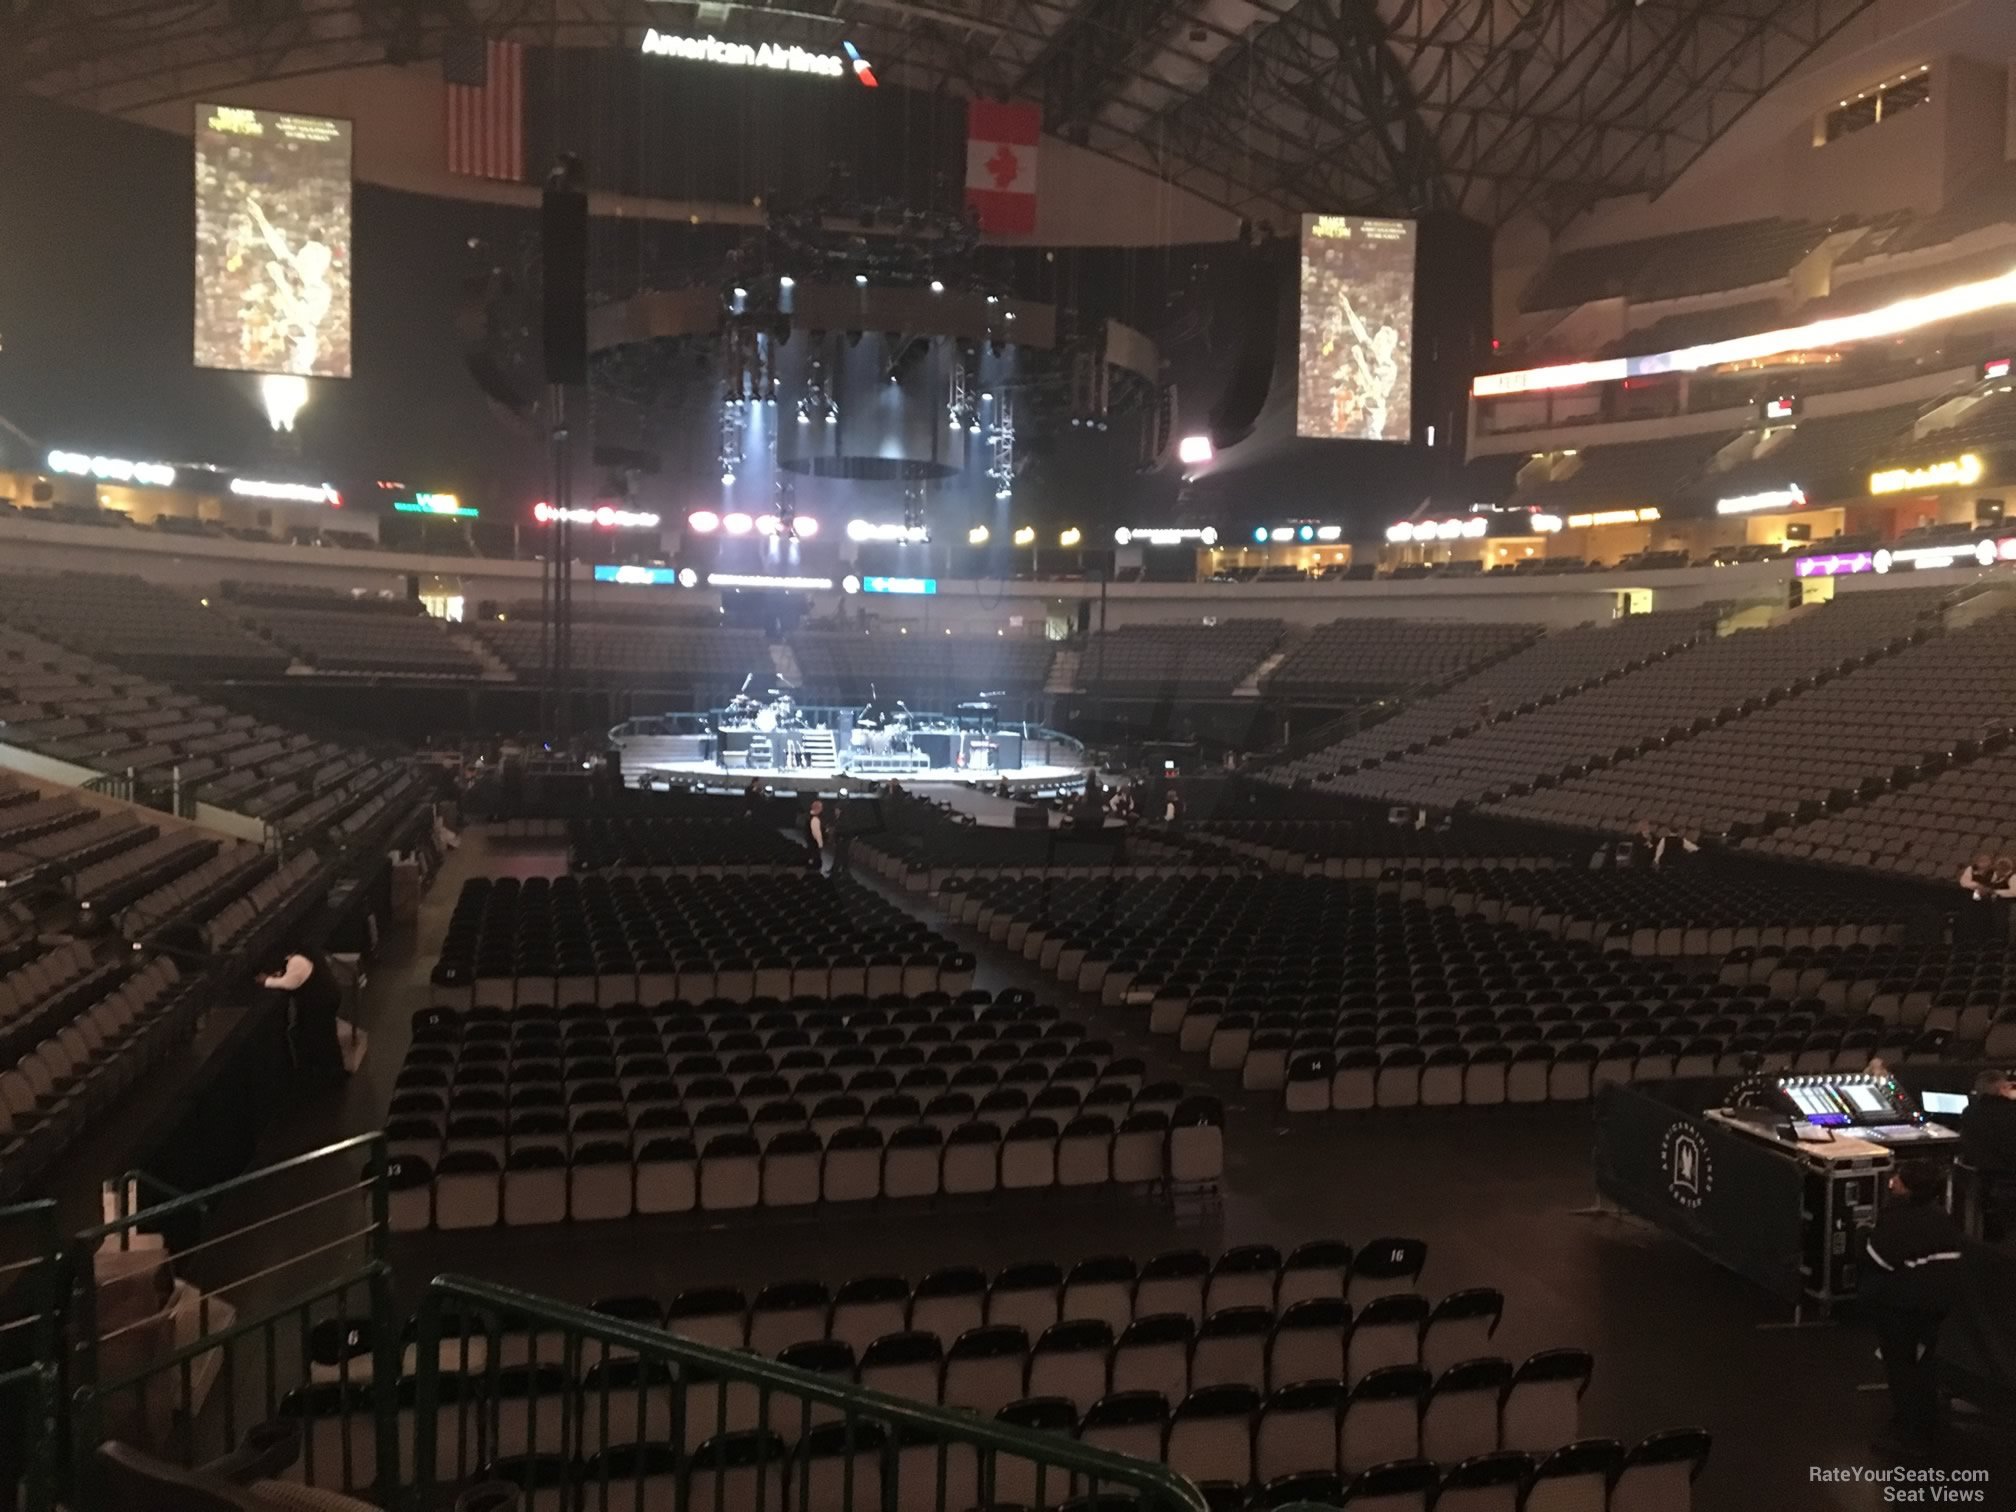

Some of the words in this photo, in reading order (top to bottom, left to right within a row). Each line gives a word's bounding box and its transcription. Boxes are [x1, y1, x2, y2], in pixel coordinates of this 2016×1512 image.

[641, 28, 755, 65] American
[756, 42, 844, 77] Airlines
[1390, 1248, 1405, 1262] 16
